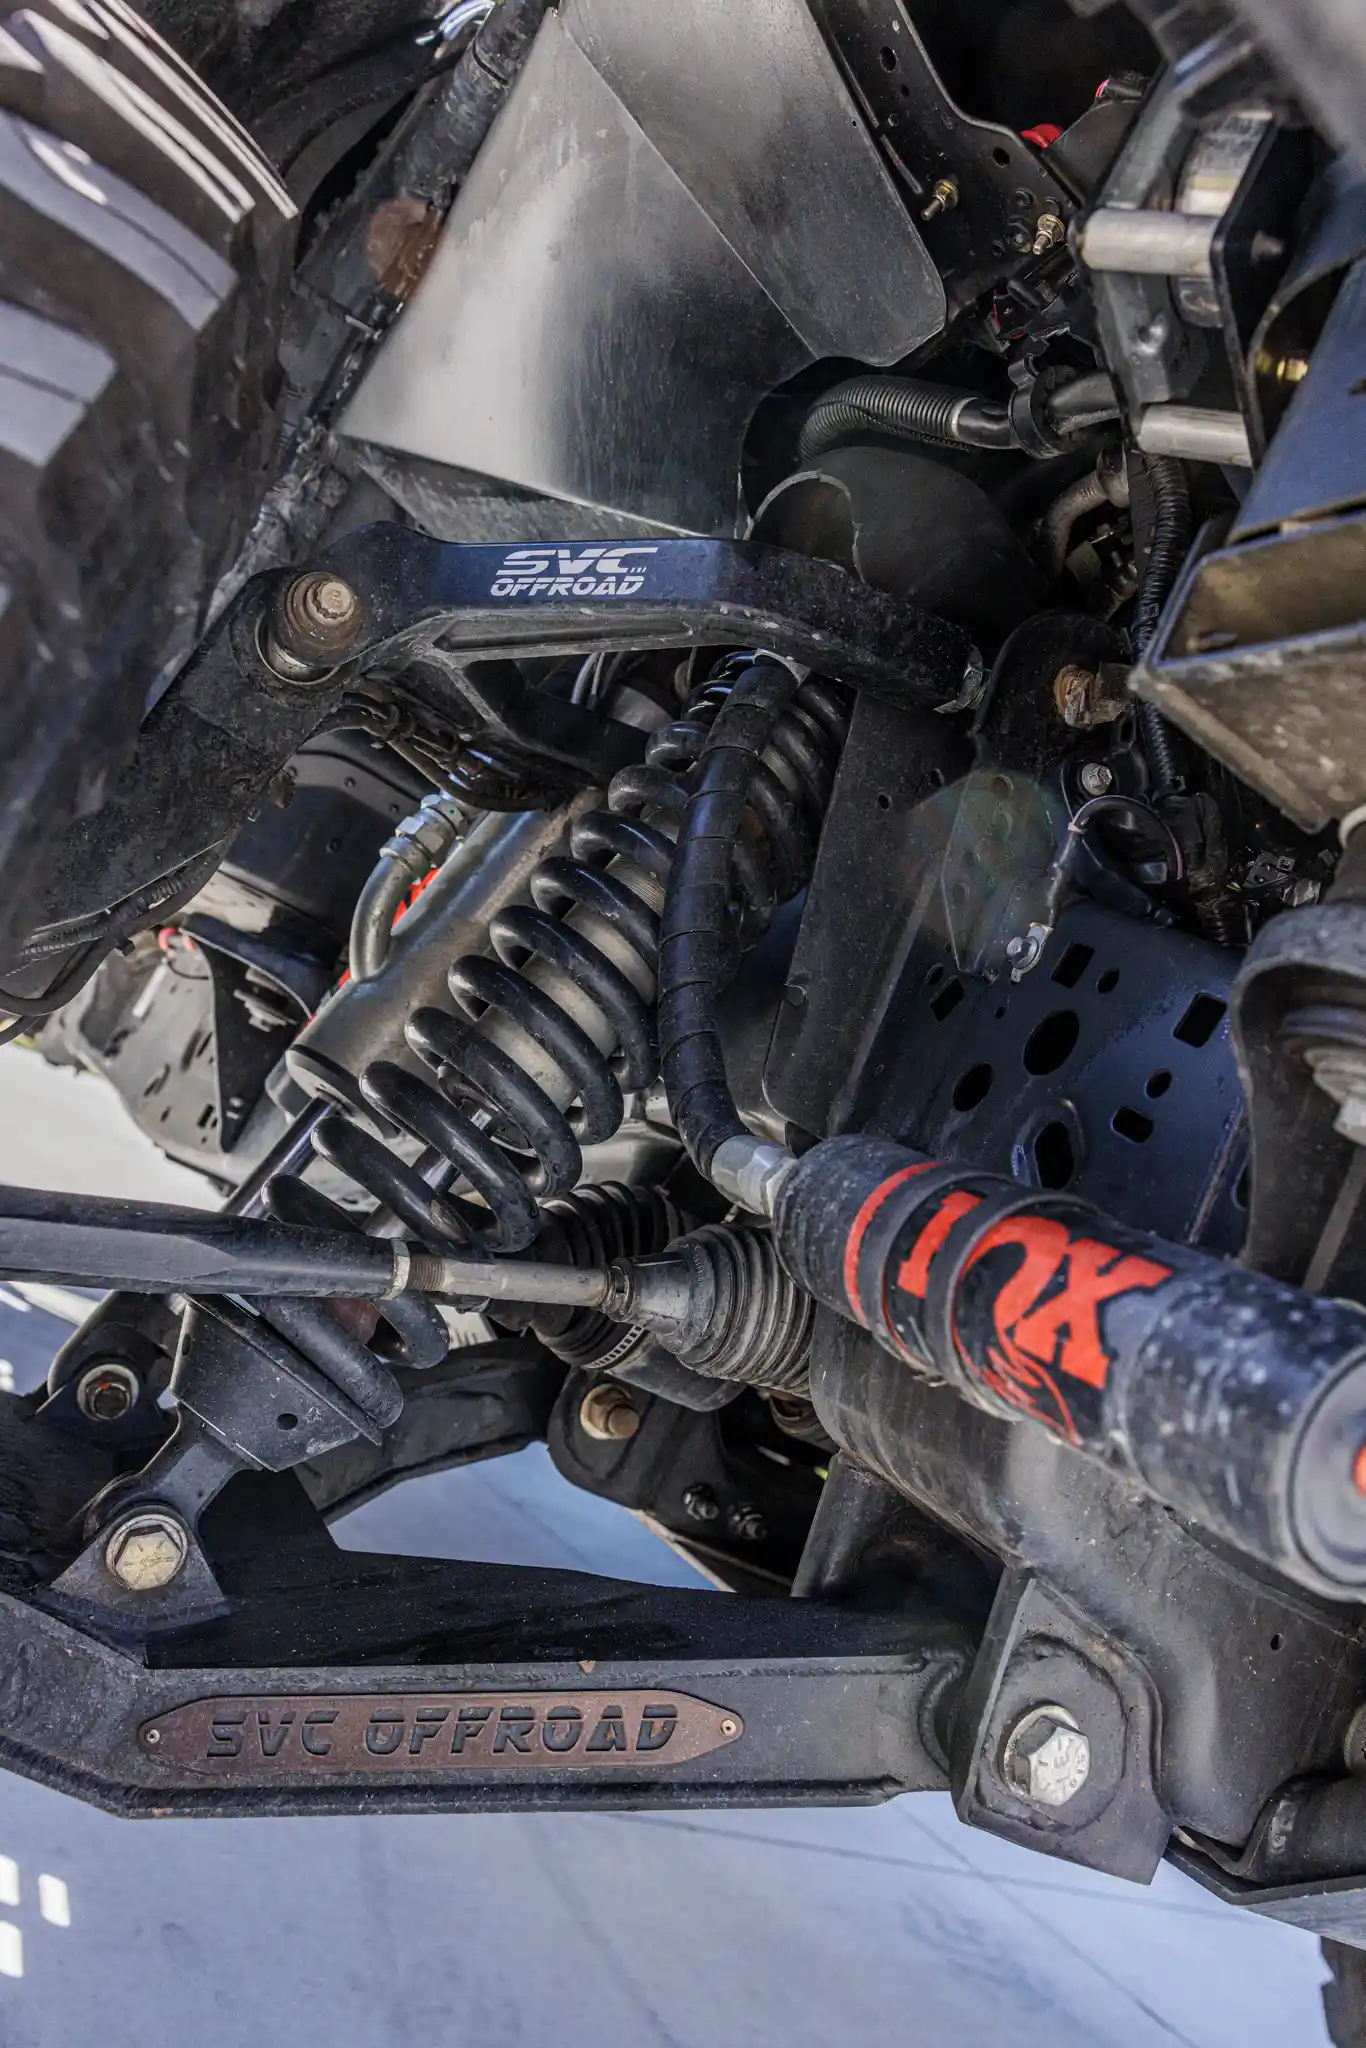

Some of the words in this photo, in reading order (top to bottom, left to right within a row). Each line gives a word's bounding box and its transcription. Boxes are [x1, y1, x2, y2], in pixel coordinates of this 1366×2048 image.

[496, 547, 658, 575] SVC
[490, 576, 645, 597] OFFROAD
[206, 1710, 340, 1757] SVC
[365, 1704, 678, 1755] OFFROAD
